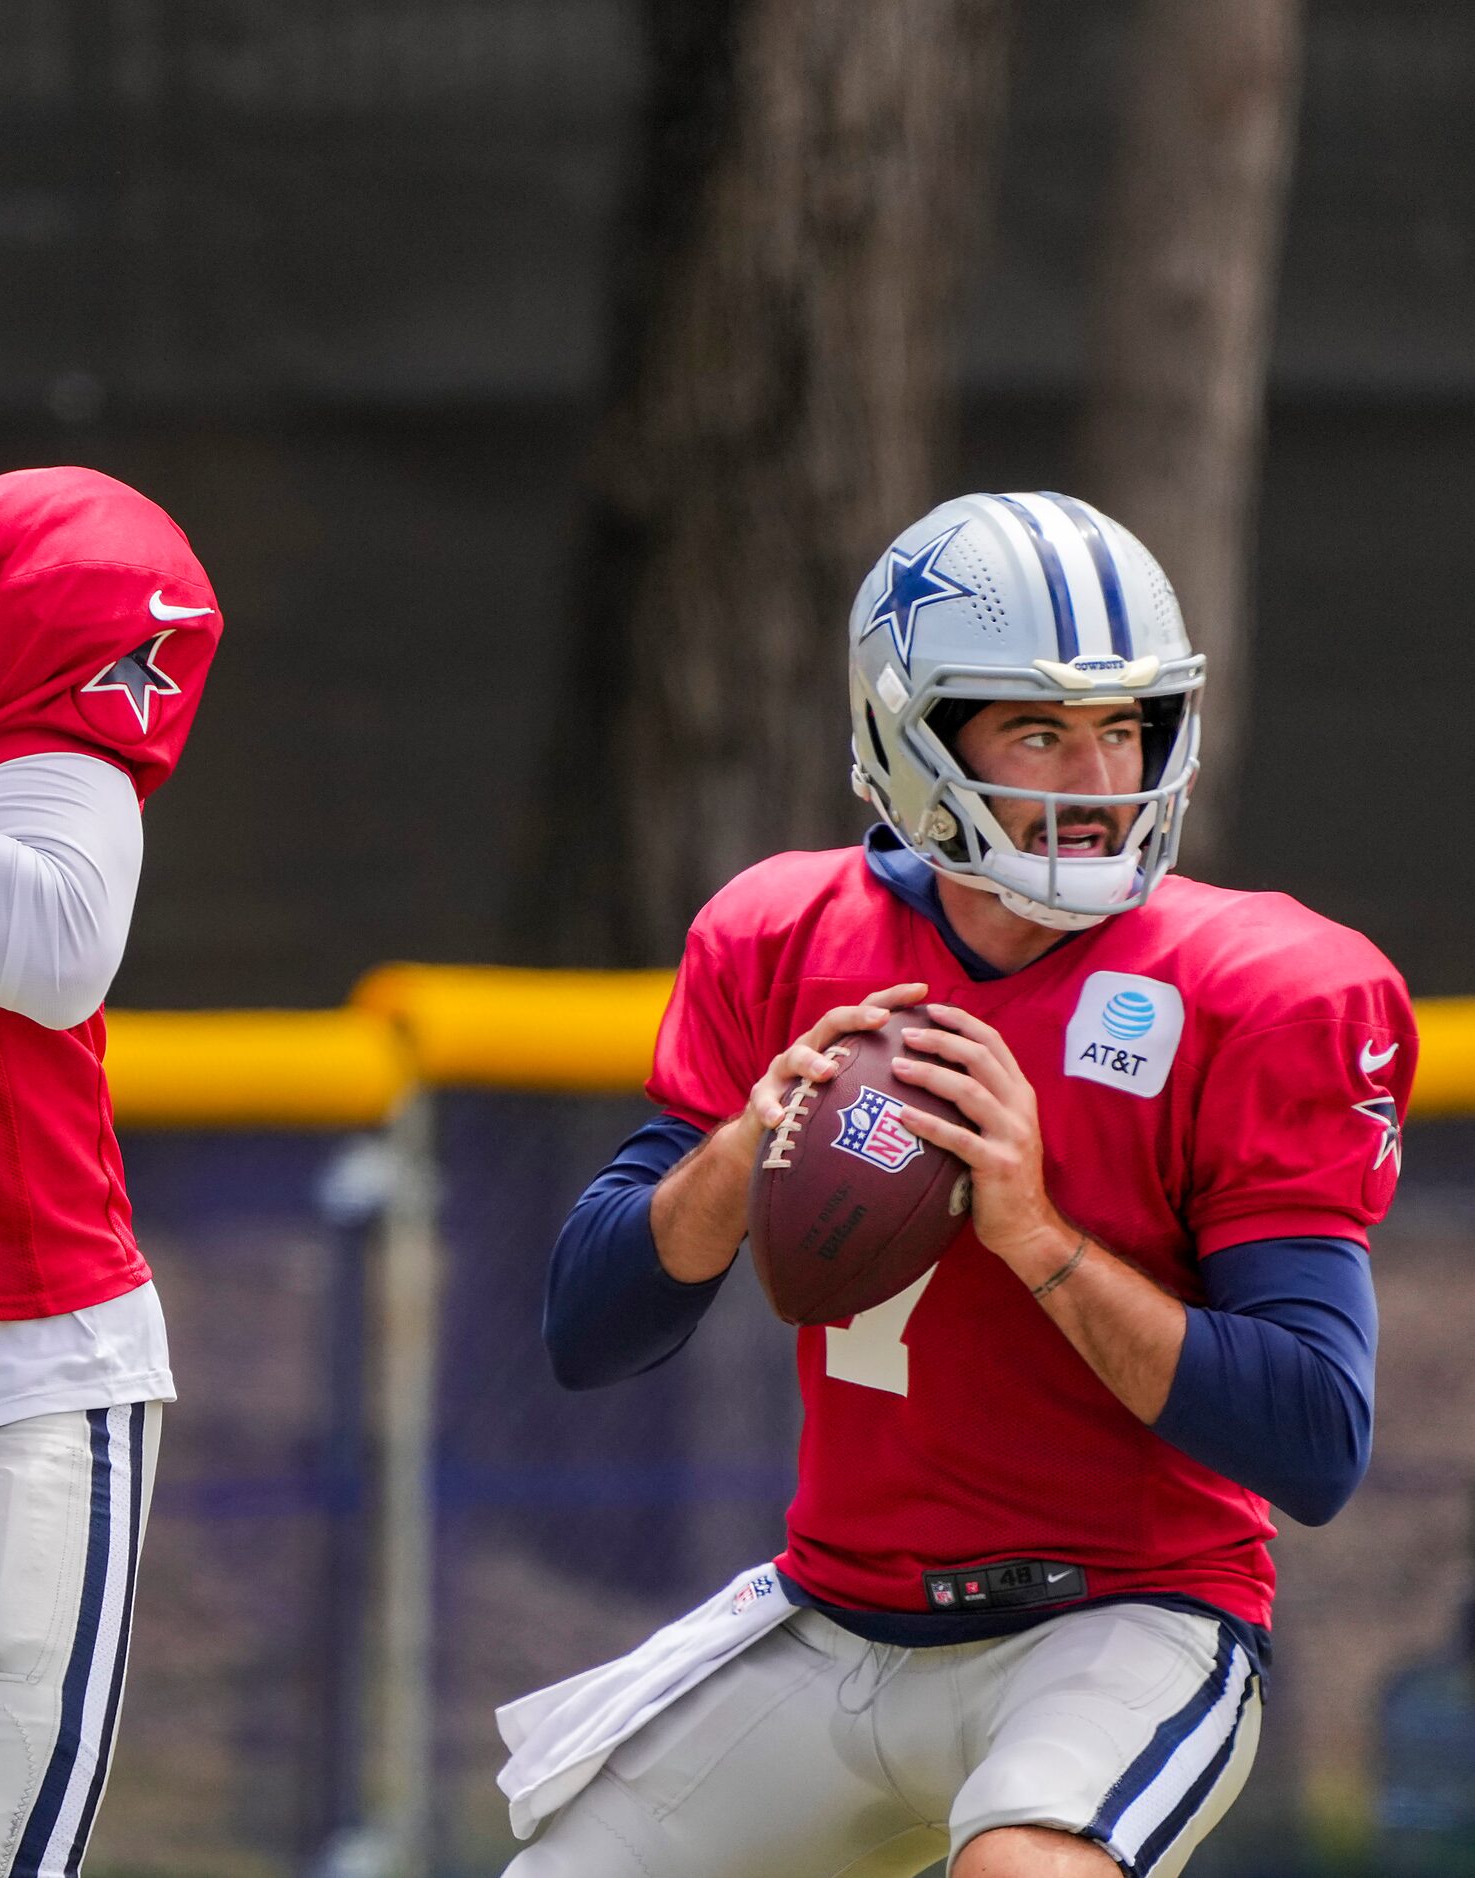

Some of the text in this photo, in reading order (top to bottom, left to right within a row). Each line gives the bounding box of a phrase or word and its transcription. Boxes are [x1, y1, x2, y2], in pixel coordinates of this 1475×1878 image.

[1074, 659, 1125, 671] COWBOYS
[1079, 1042, 1148, 1076] AT&T
[999, 1566, 1032, 1587] 48
